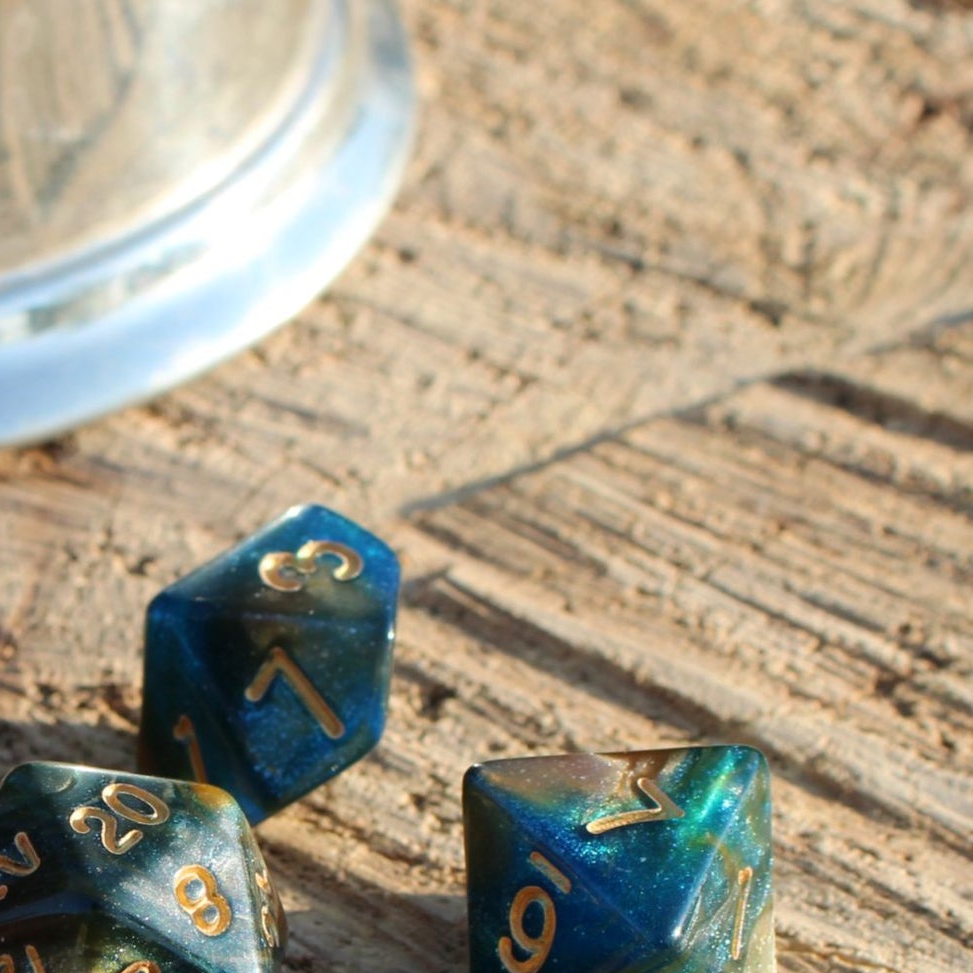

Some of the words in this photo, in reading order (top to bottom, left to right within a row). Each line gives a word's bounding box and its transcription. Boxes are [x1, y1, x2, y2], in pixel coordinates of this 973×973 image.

[259, 540, 363, 592] 3
[245, 647, 345, 739] 7
[69, 783, 170, 854] 20
[175, 864, 231, 937] 8
